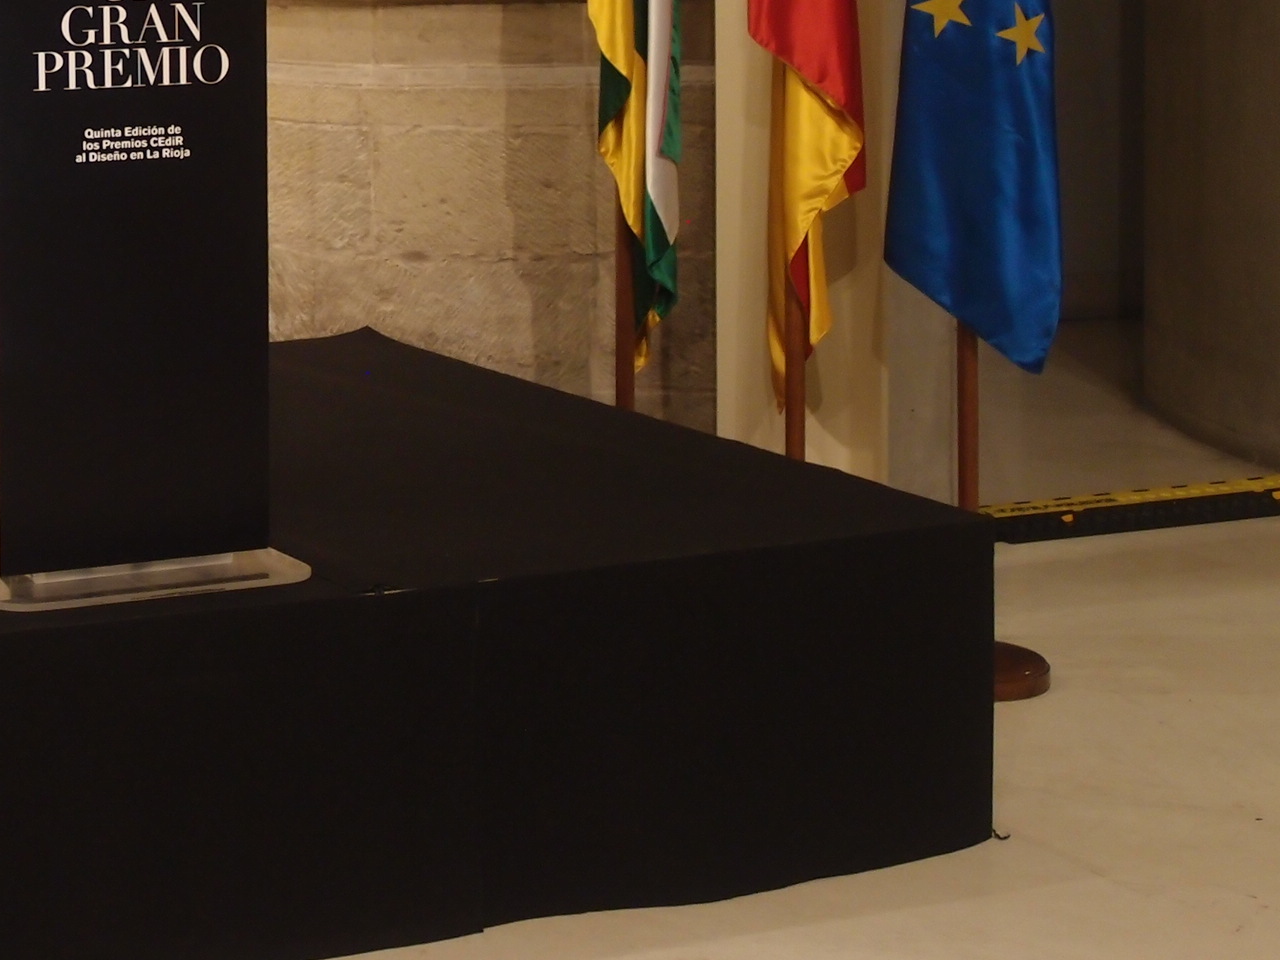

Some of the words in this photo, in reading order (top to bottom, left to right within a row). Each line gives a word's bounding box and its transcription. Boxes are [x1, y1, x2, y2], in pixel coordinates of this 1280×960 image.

[60, 2, 206, 47] GRAN
[32, 43, 230, 92] PREMIO
[84, 128, 122, 139] Quinta
[124, 125, 165, 137] Edición
[167, 124, 182, 134] de
[82, 140, 100, 151] los
[102, 138, 148, 150] Premios
[149, 135, 184, 147] CEdiR
[75, 152, 86, 163] al
[88, 150, 128, 162] Diseño
[129, 151, 144, 160] en
[146, 148, 160, 159] La
[162, 147, 191, 159] Rioja
